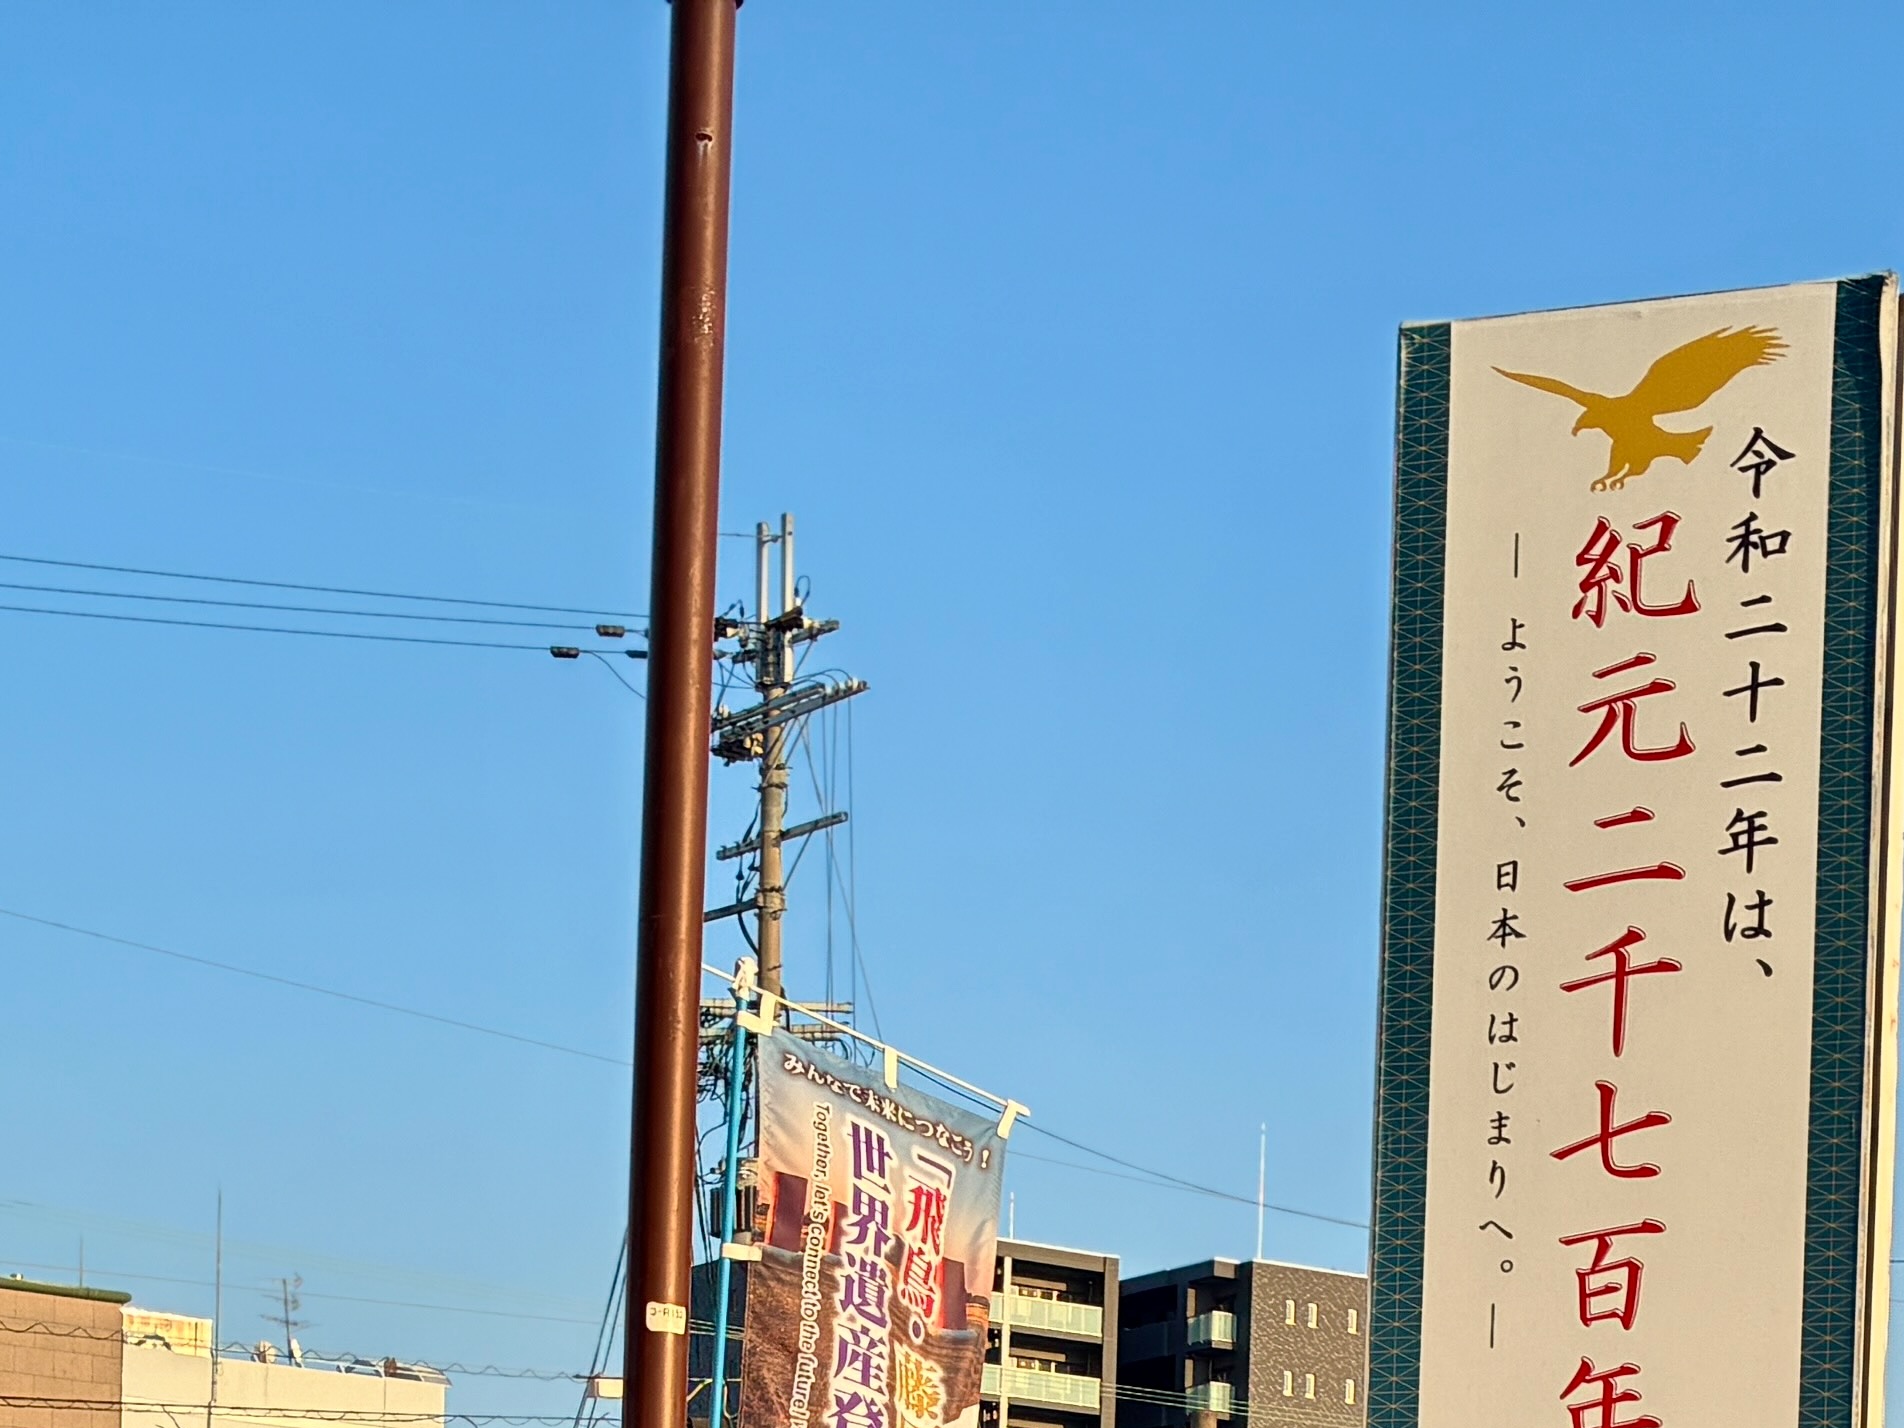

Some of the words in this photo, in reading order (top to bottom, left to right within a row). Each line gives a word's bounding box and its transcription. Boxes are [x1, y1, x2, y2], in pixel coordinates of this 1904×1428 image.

[1717, 426, 1796, 978] 令和二十二年は、
[804, 1225, 823, 1297] connect
[804, 1300, 819, 1318] to
[801, 1323, 817, 1350] the
